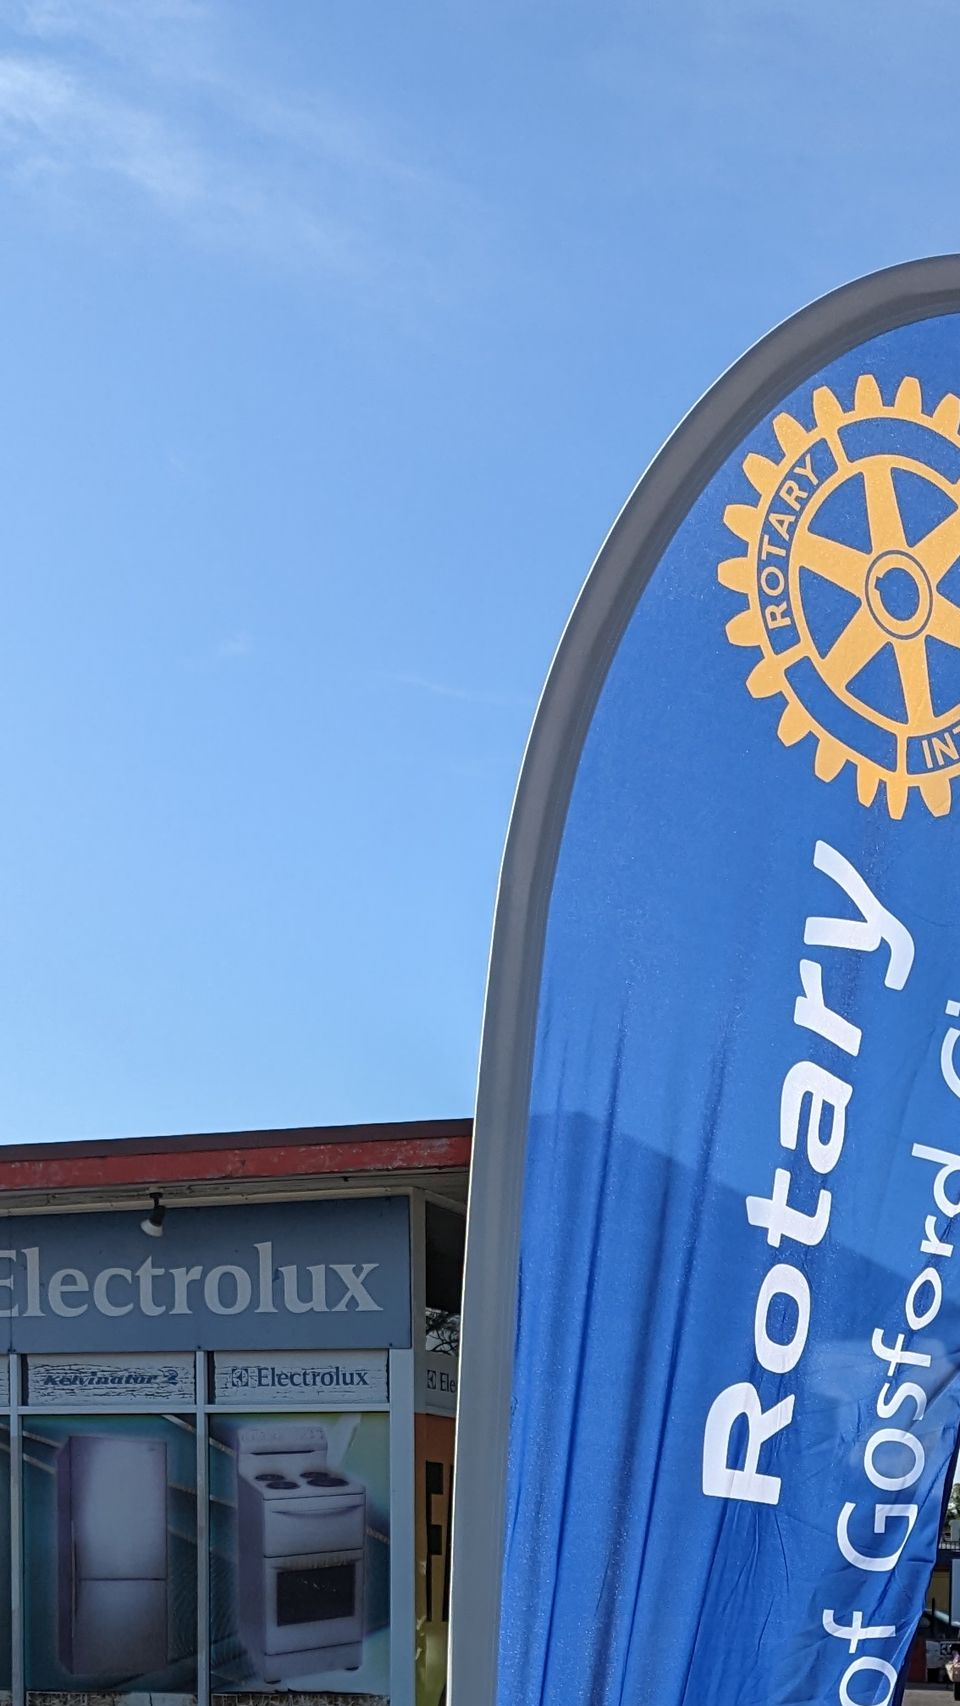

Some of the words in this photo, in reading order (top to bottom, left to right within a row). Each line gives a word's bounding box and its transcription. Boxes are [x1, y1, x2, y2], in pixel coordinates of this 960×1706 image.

[760, 453, 821, 630] ROTARY
[702, 840, 915, 1505] Rotary
[257, 1366, 369, 1387] Electrolux
